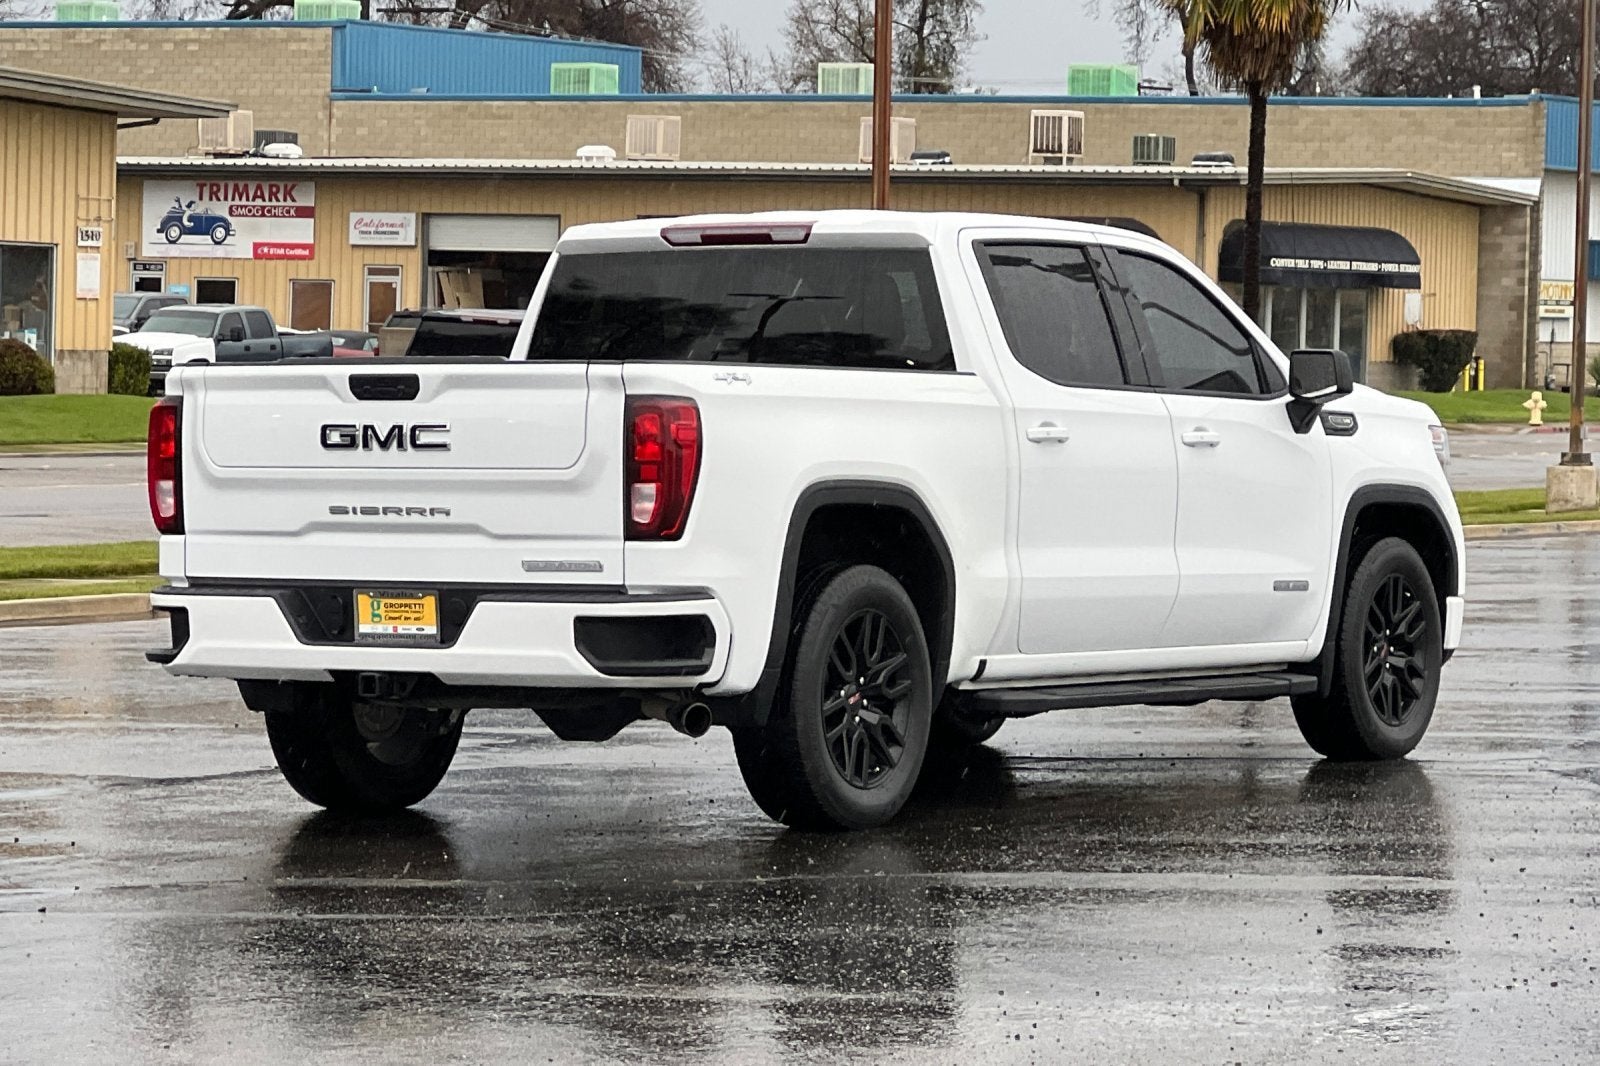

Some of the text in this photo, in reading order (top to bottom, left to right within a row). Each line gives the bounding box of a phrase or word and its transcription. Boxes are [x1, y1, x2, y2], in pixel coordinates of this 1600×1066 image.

[196, 182, 297, 203] TRIMARK
[231, 206, 296, 217] SMOG CHECK
[354, 217, 405, 230] California
[80, 229, 101, 241] 1510
[270, 247, 309, 255] STAR Certified
[320, 423, 451, 451] GMC
[329, 505, 451, 516] SIERRA
